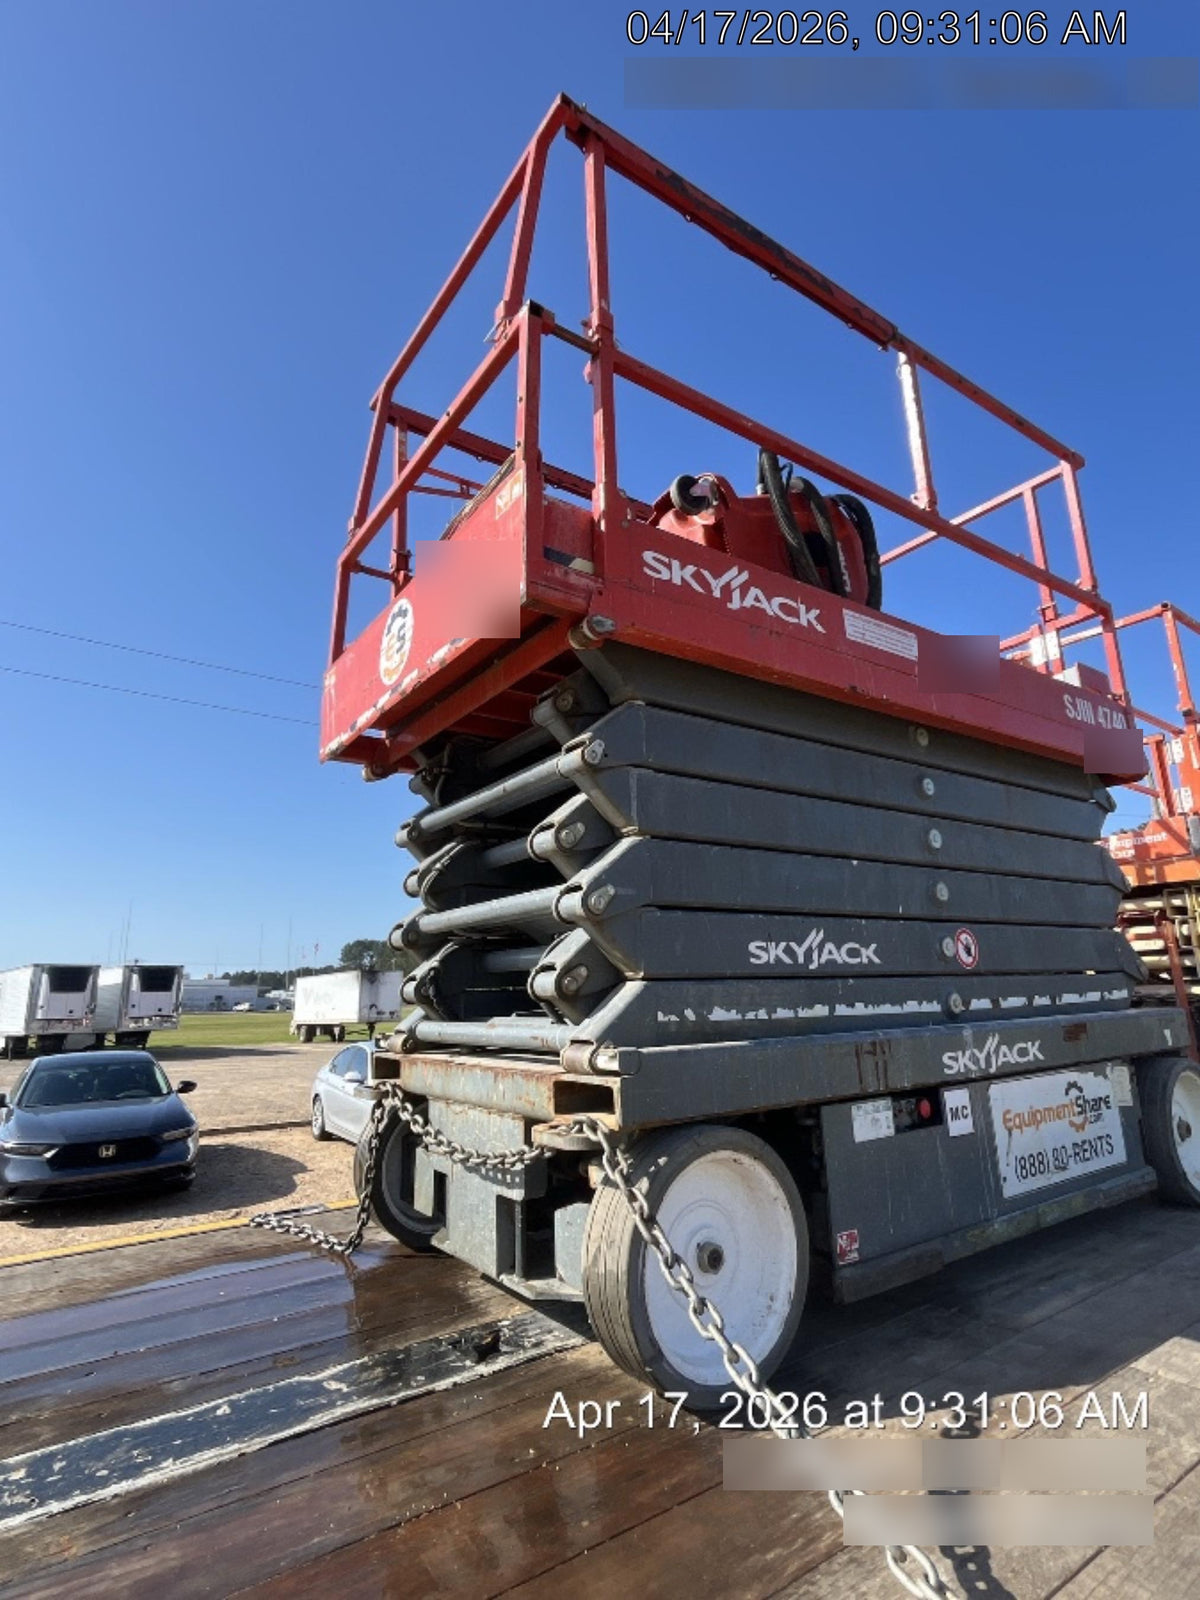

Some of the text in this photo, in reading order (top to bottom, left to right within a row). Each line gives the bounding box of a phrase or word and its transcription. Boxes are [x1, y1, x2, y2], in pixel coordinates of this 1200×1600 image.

[641, 549, 826, 633] SKYJACK
[748, 928, 882, 970] SKYJACK
[942, 1033, 1045, 1074] SKYJACK
[1002, 1094, 1112, 1134] EquipmentShare
[1014, 1148, 1051, 1183] (888)
